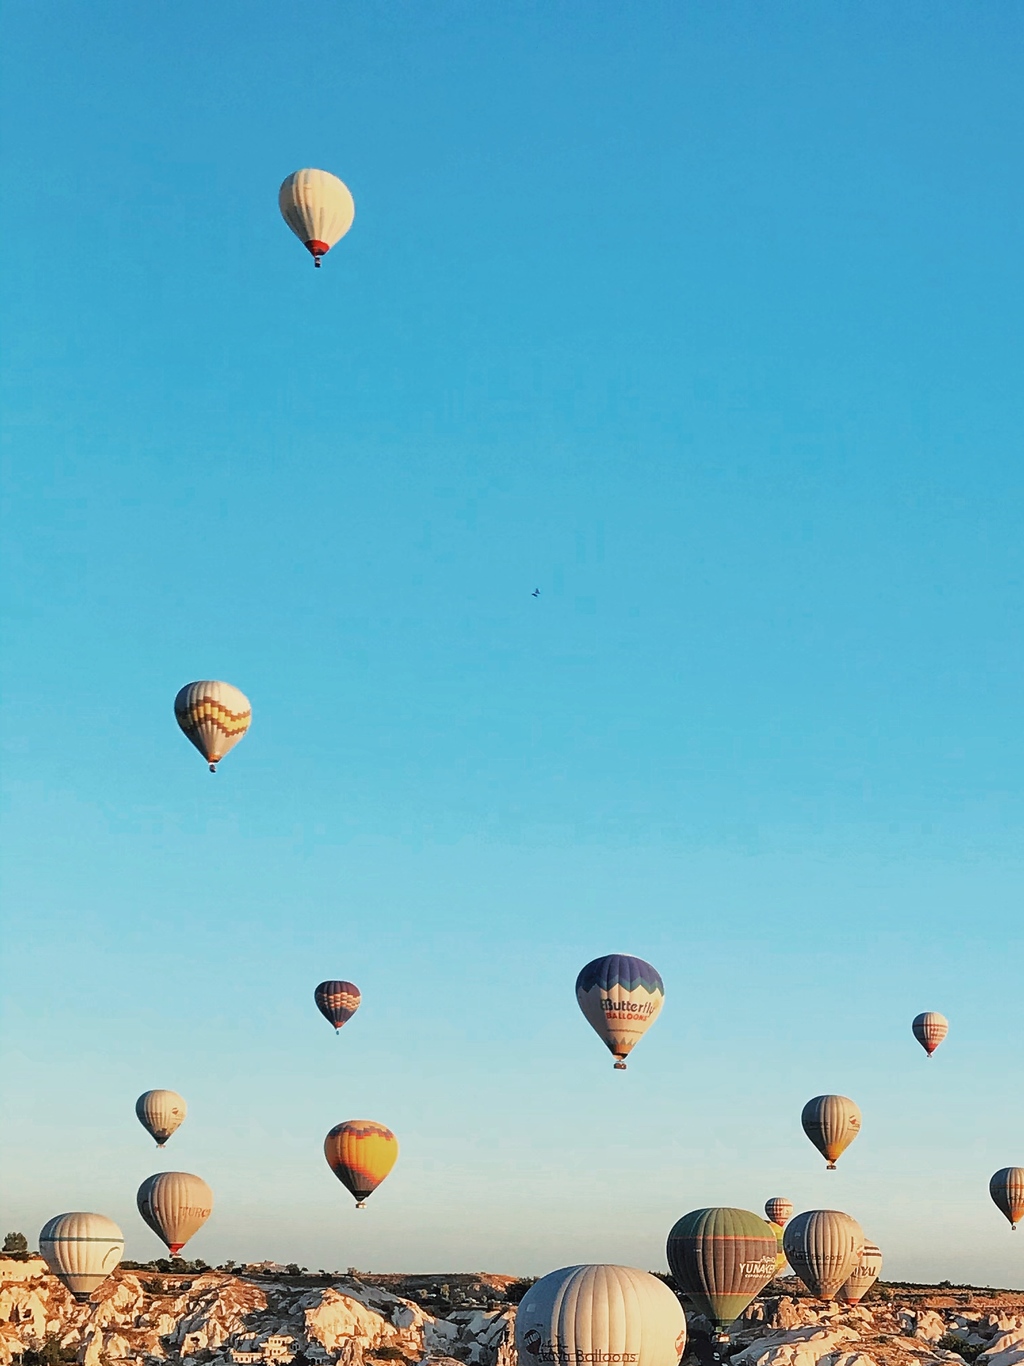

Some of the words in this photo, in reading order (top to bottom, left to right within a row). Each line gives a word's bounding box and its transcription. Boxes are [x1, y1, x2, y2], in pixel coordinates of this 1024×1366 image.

[600, 998, 656, 1018] Butterfly
[605, 1012, 649, 1022] BALLOONS
[576, 1348, 637, 1363] Balloons
